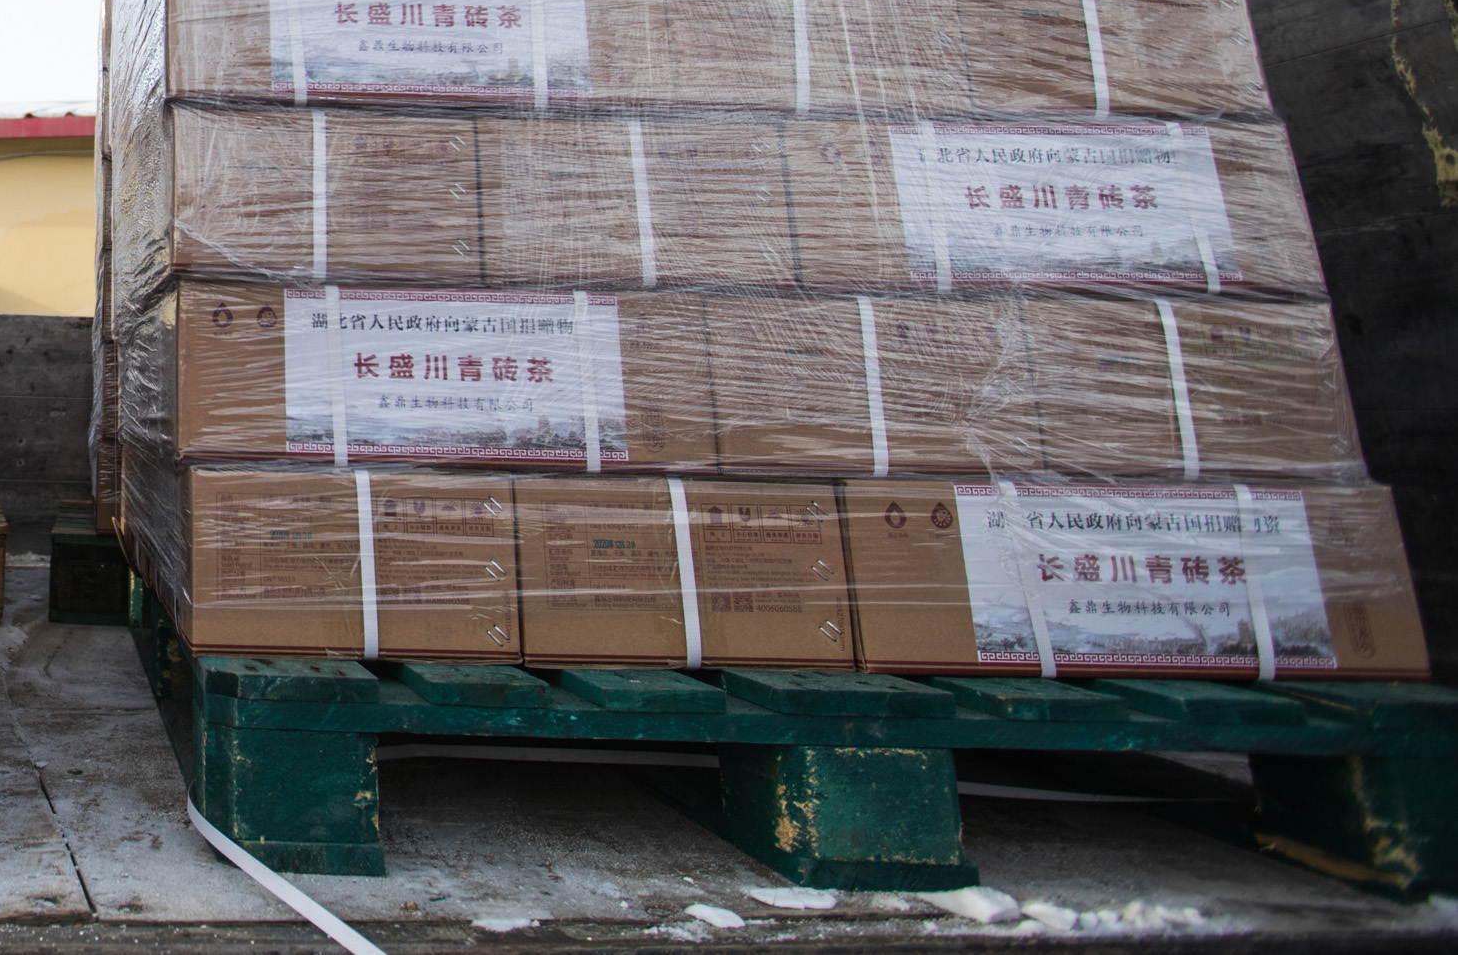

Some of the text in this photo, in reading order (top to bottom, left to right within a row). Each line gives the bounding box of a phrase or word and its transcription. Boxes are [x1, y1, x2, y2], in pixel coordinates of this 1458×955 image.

[334, 1, 522, 29] 长盛川青砖茶
[358, 39, 504, 55] 鑫鼎生物科技有限公司
[964, 183, 1159, 211] 长盛川青砖茶
[353, 351, 555, 384] 长盛川青砖茶
[378, 394, 535, 413] 鑫鼎生物科技有限公司
[986, 510, 1282, 535] 湖省人民政府向蒙古国捐赠资
[1036, 553, 1247, 586] 长盛川青砖茶
[1068, 598, 1231, 618] 鑫鼎生物科技有限公司
